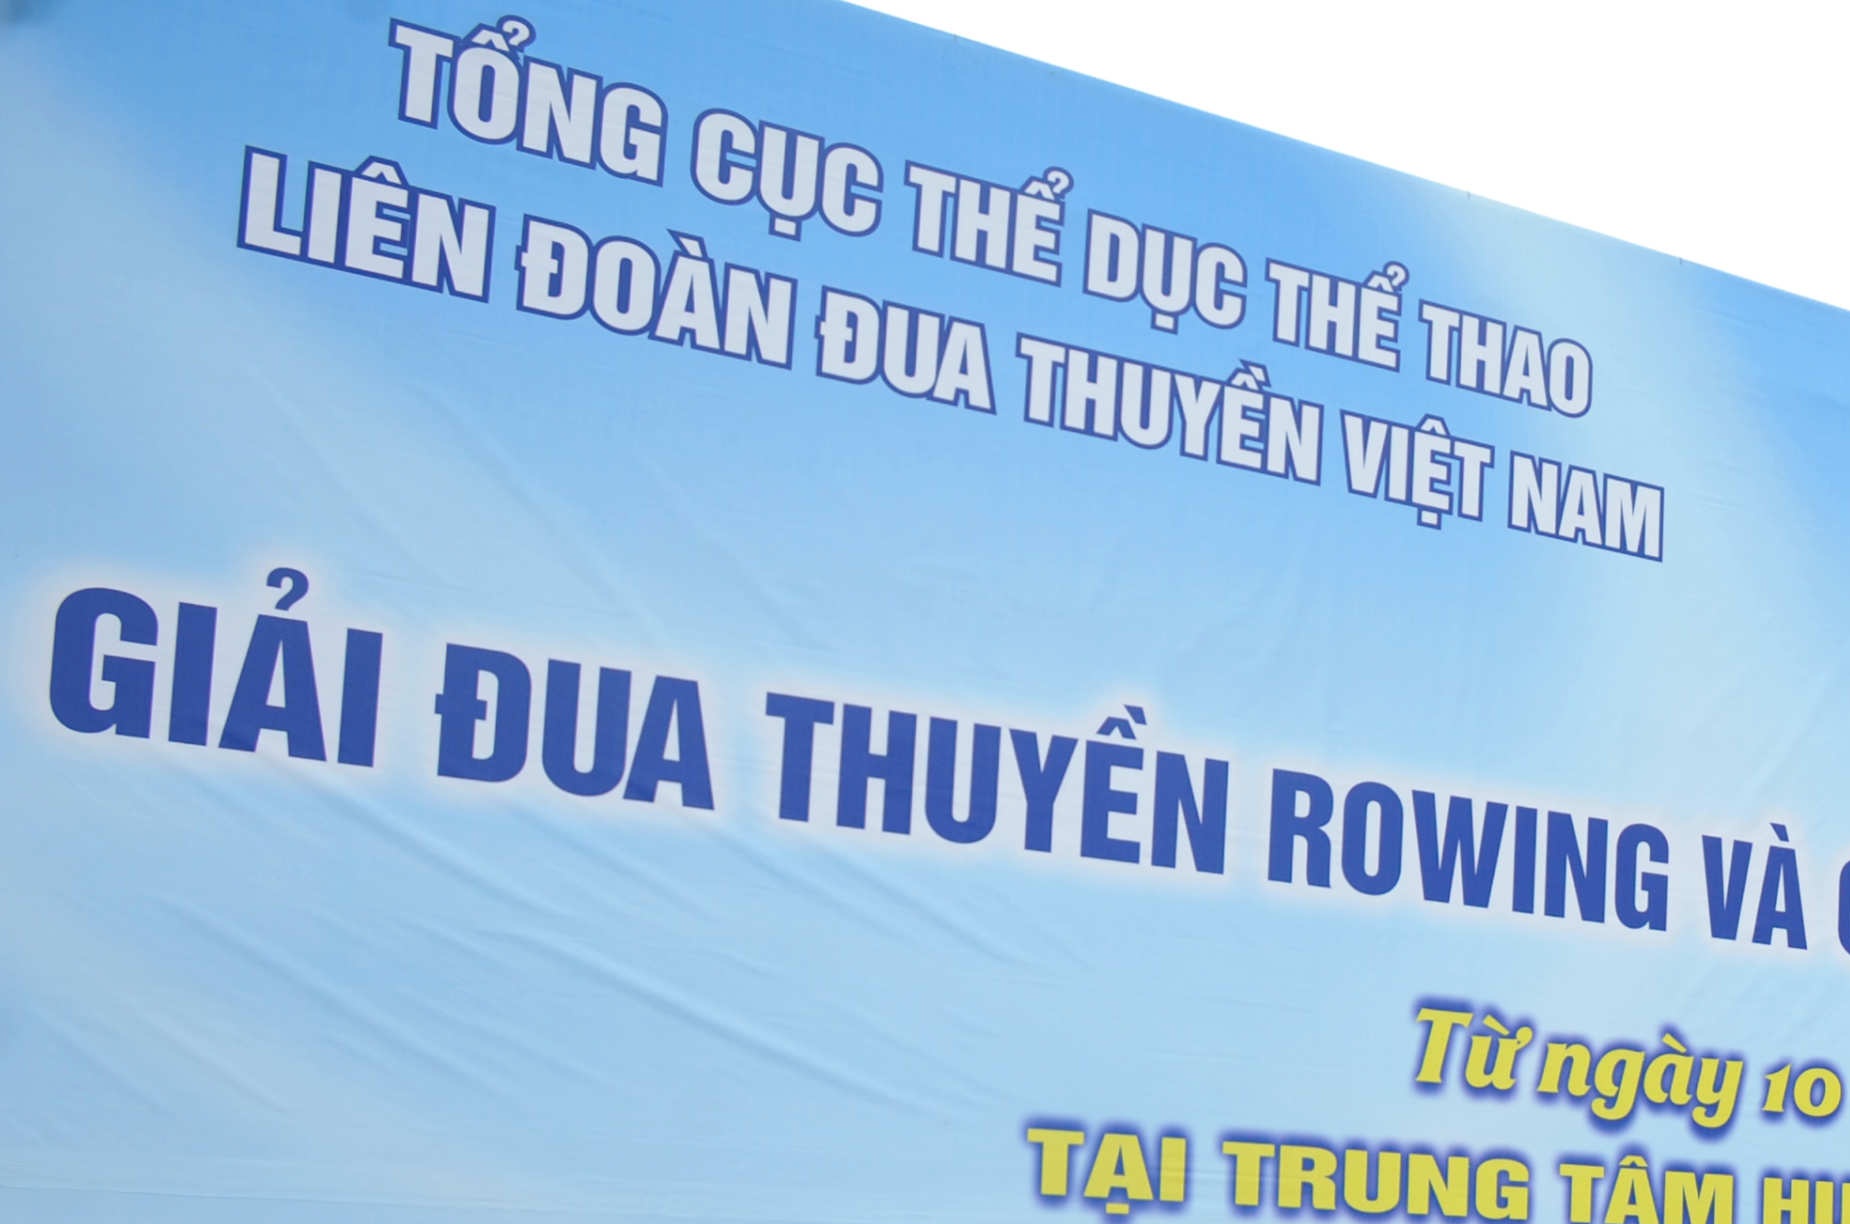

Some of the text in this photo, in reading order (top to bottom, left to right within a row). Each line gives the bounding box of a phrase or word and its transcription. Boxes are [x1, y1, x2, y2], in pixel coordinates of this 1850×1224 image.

[236, 146, 1664, 562] LIÊN ĐOÀN ĐUA THUYỀN VIỆT NAM
[389, 15, 1592, 417] TỔNG CỤC THỂ DỤC THỂ THAO
[49, 567, 383, 768] GIẢI
[435, 642, 714, 811] ĐUA
[766, 692, 1229, 875] THUYỀN
[1267, 768, 1670, 932] ROWING
[1702, 822, 1807, 950] VÀ
[1027, 1128, 1187, 1215] TẠI
[1222, 1141, 1530, 1220] TRUNG
[1414, 1007, 1533, 1092] Từ
[1537, 1033, 1743, 1129] ngày
[1764, 1064, 1842, 1117] 10
